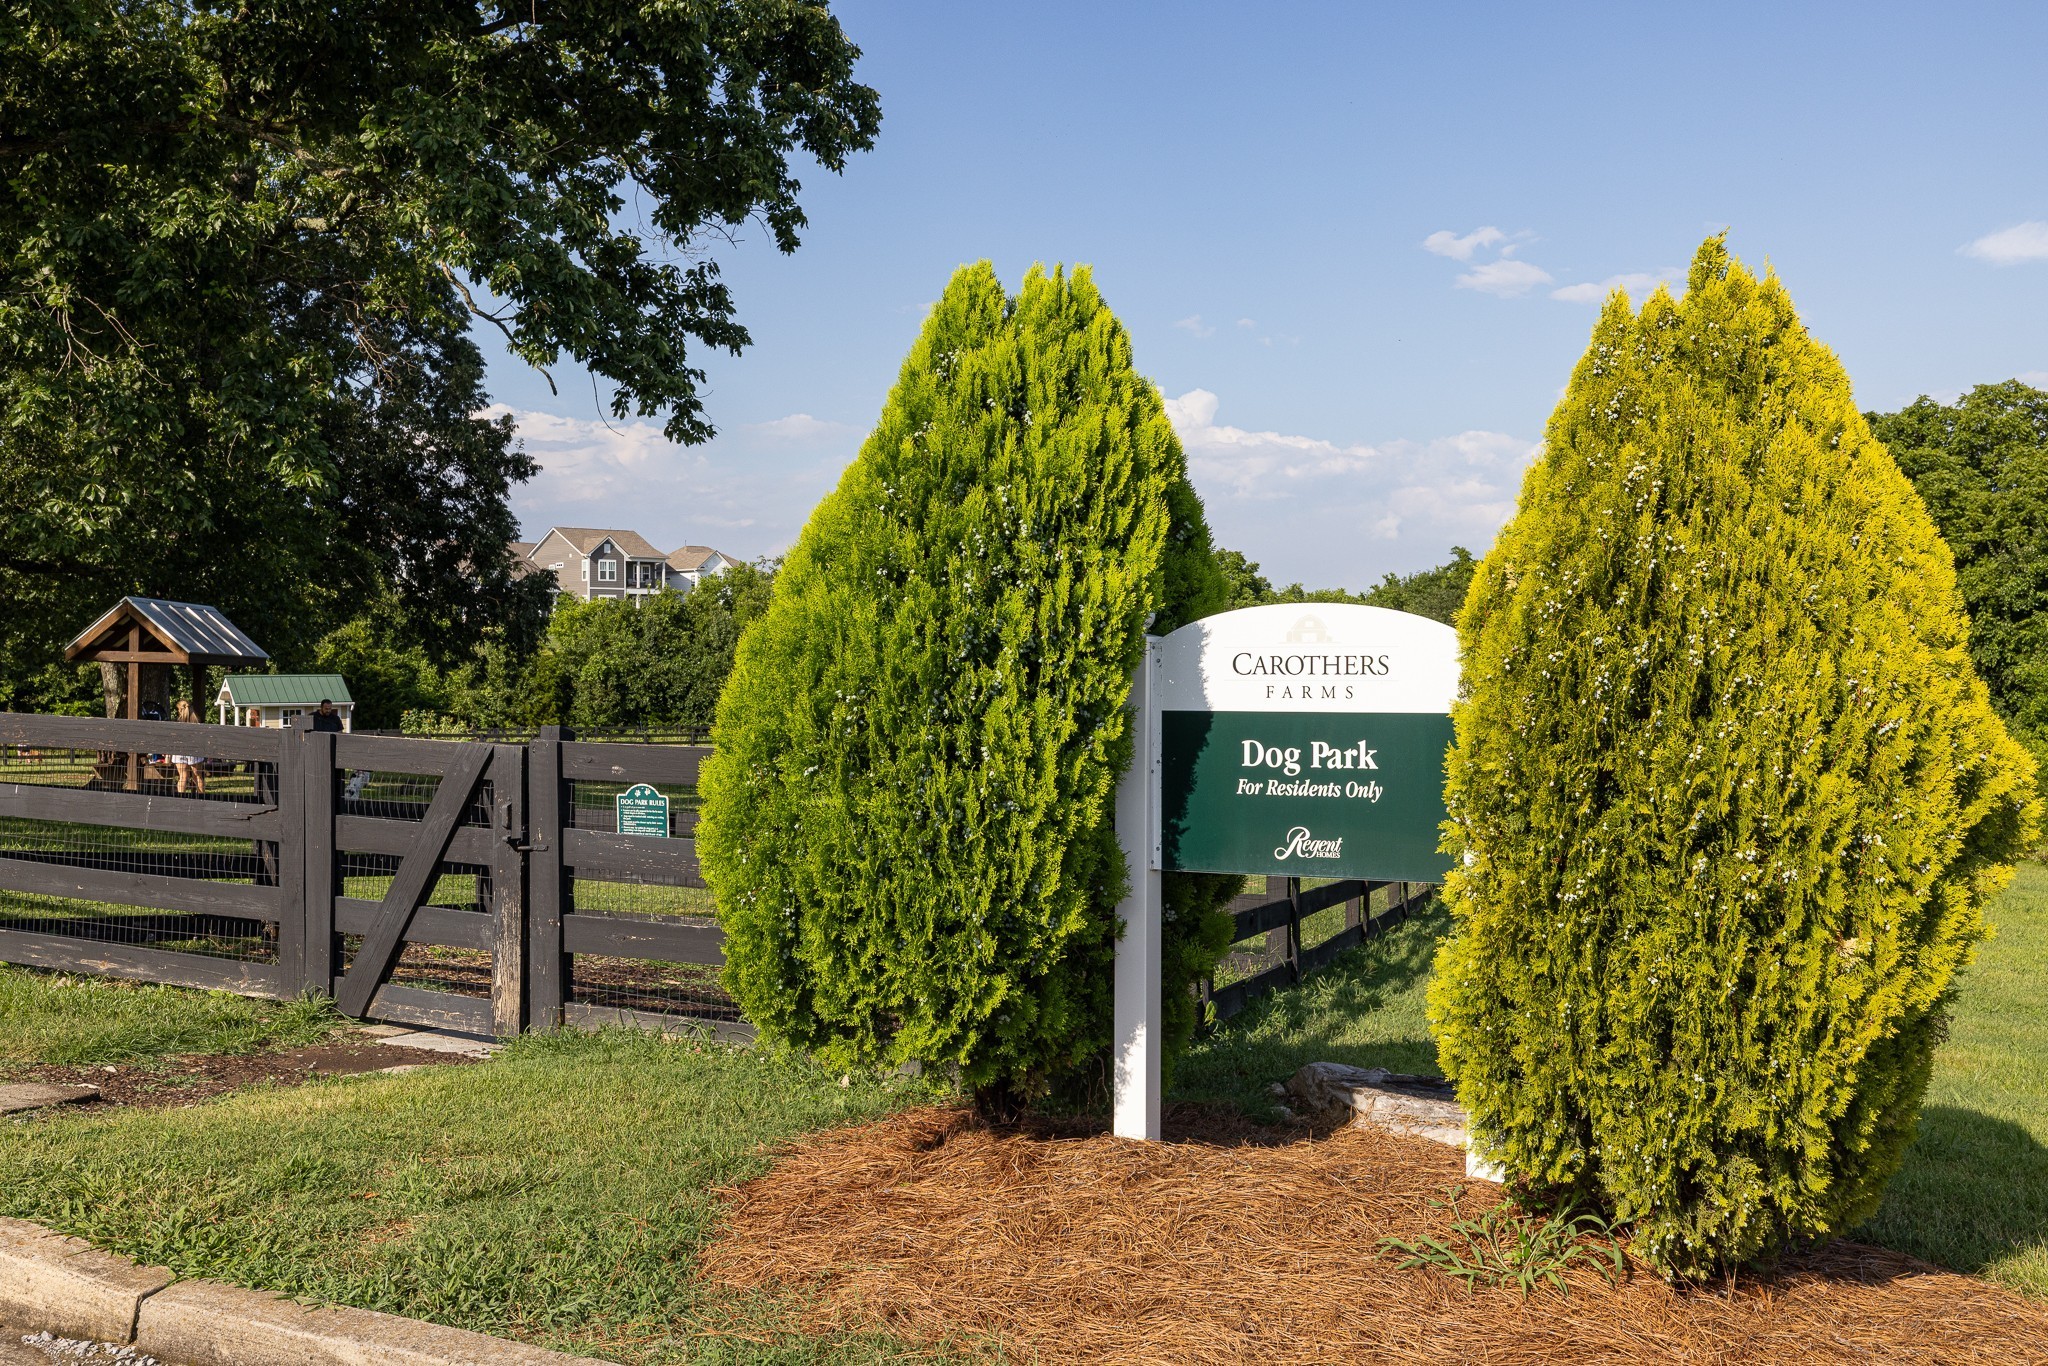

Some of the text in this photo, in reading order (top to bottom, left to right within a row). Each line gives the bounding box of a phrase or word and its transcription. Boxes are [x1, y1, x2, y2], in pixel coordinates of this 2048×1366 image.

[1232, 652, 1390, 676] CAROTHERS
[1266, 685, 1354, 699] FARMS
[1241, 739, 1379, 776] Dog Park
[1236, 778, 1383, 803] For Residents Only
[1274, 826, 1343, 860] Regent
[1316, 851, 1341, 859] HOMES
